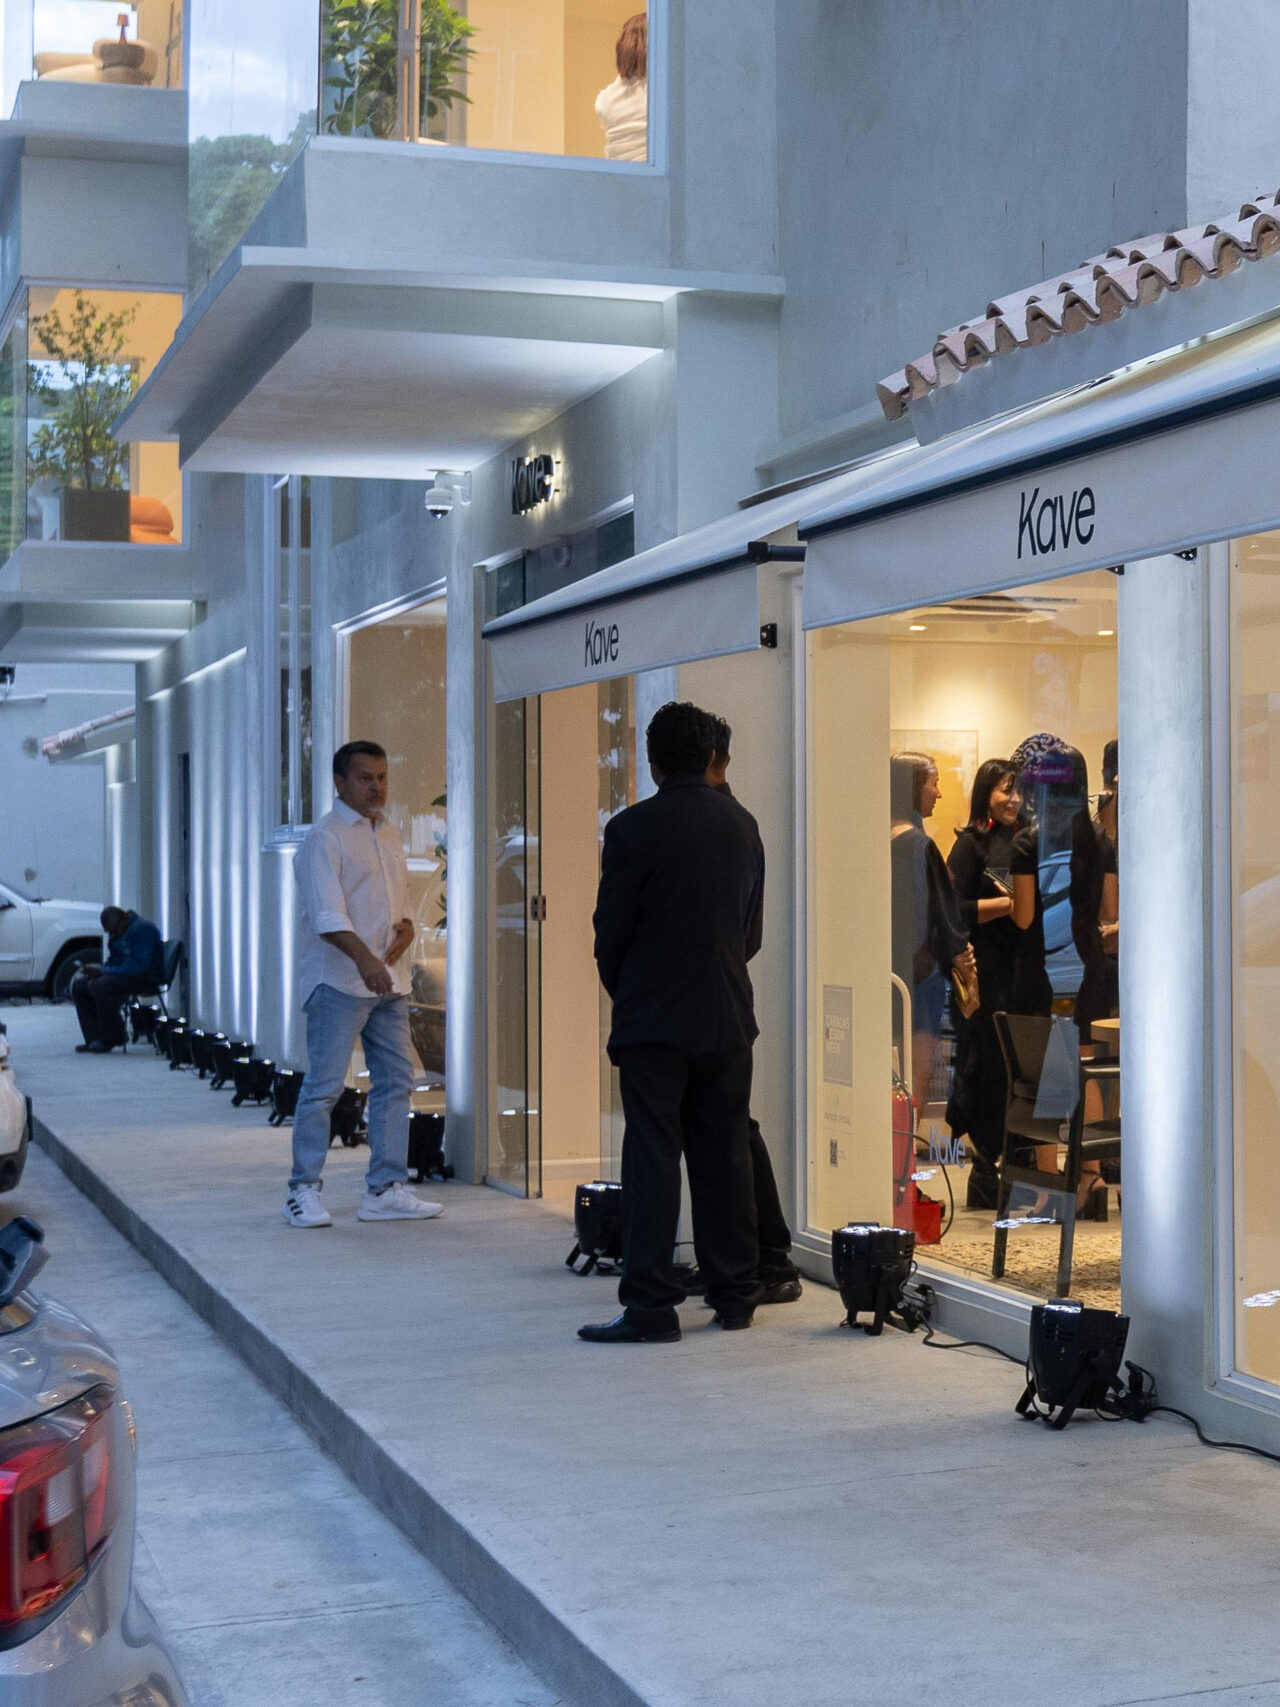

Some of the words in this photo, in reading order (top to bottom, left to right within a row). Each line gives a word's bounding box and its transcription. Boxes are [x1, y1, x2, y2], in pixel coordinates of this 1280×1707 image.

[511, 454, 553, 515] Kave
[1017, 487, 1096, 560] Kave
[585, 620, 619, 668] Kave
[929, 1126, 966, 1168] Kave
